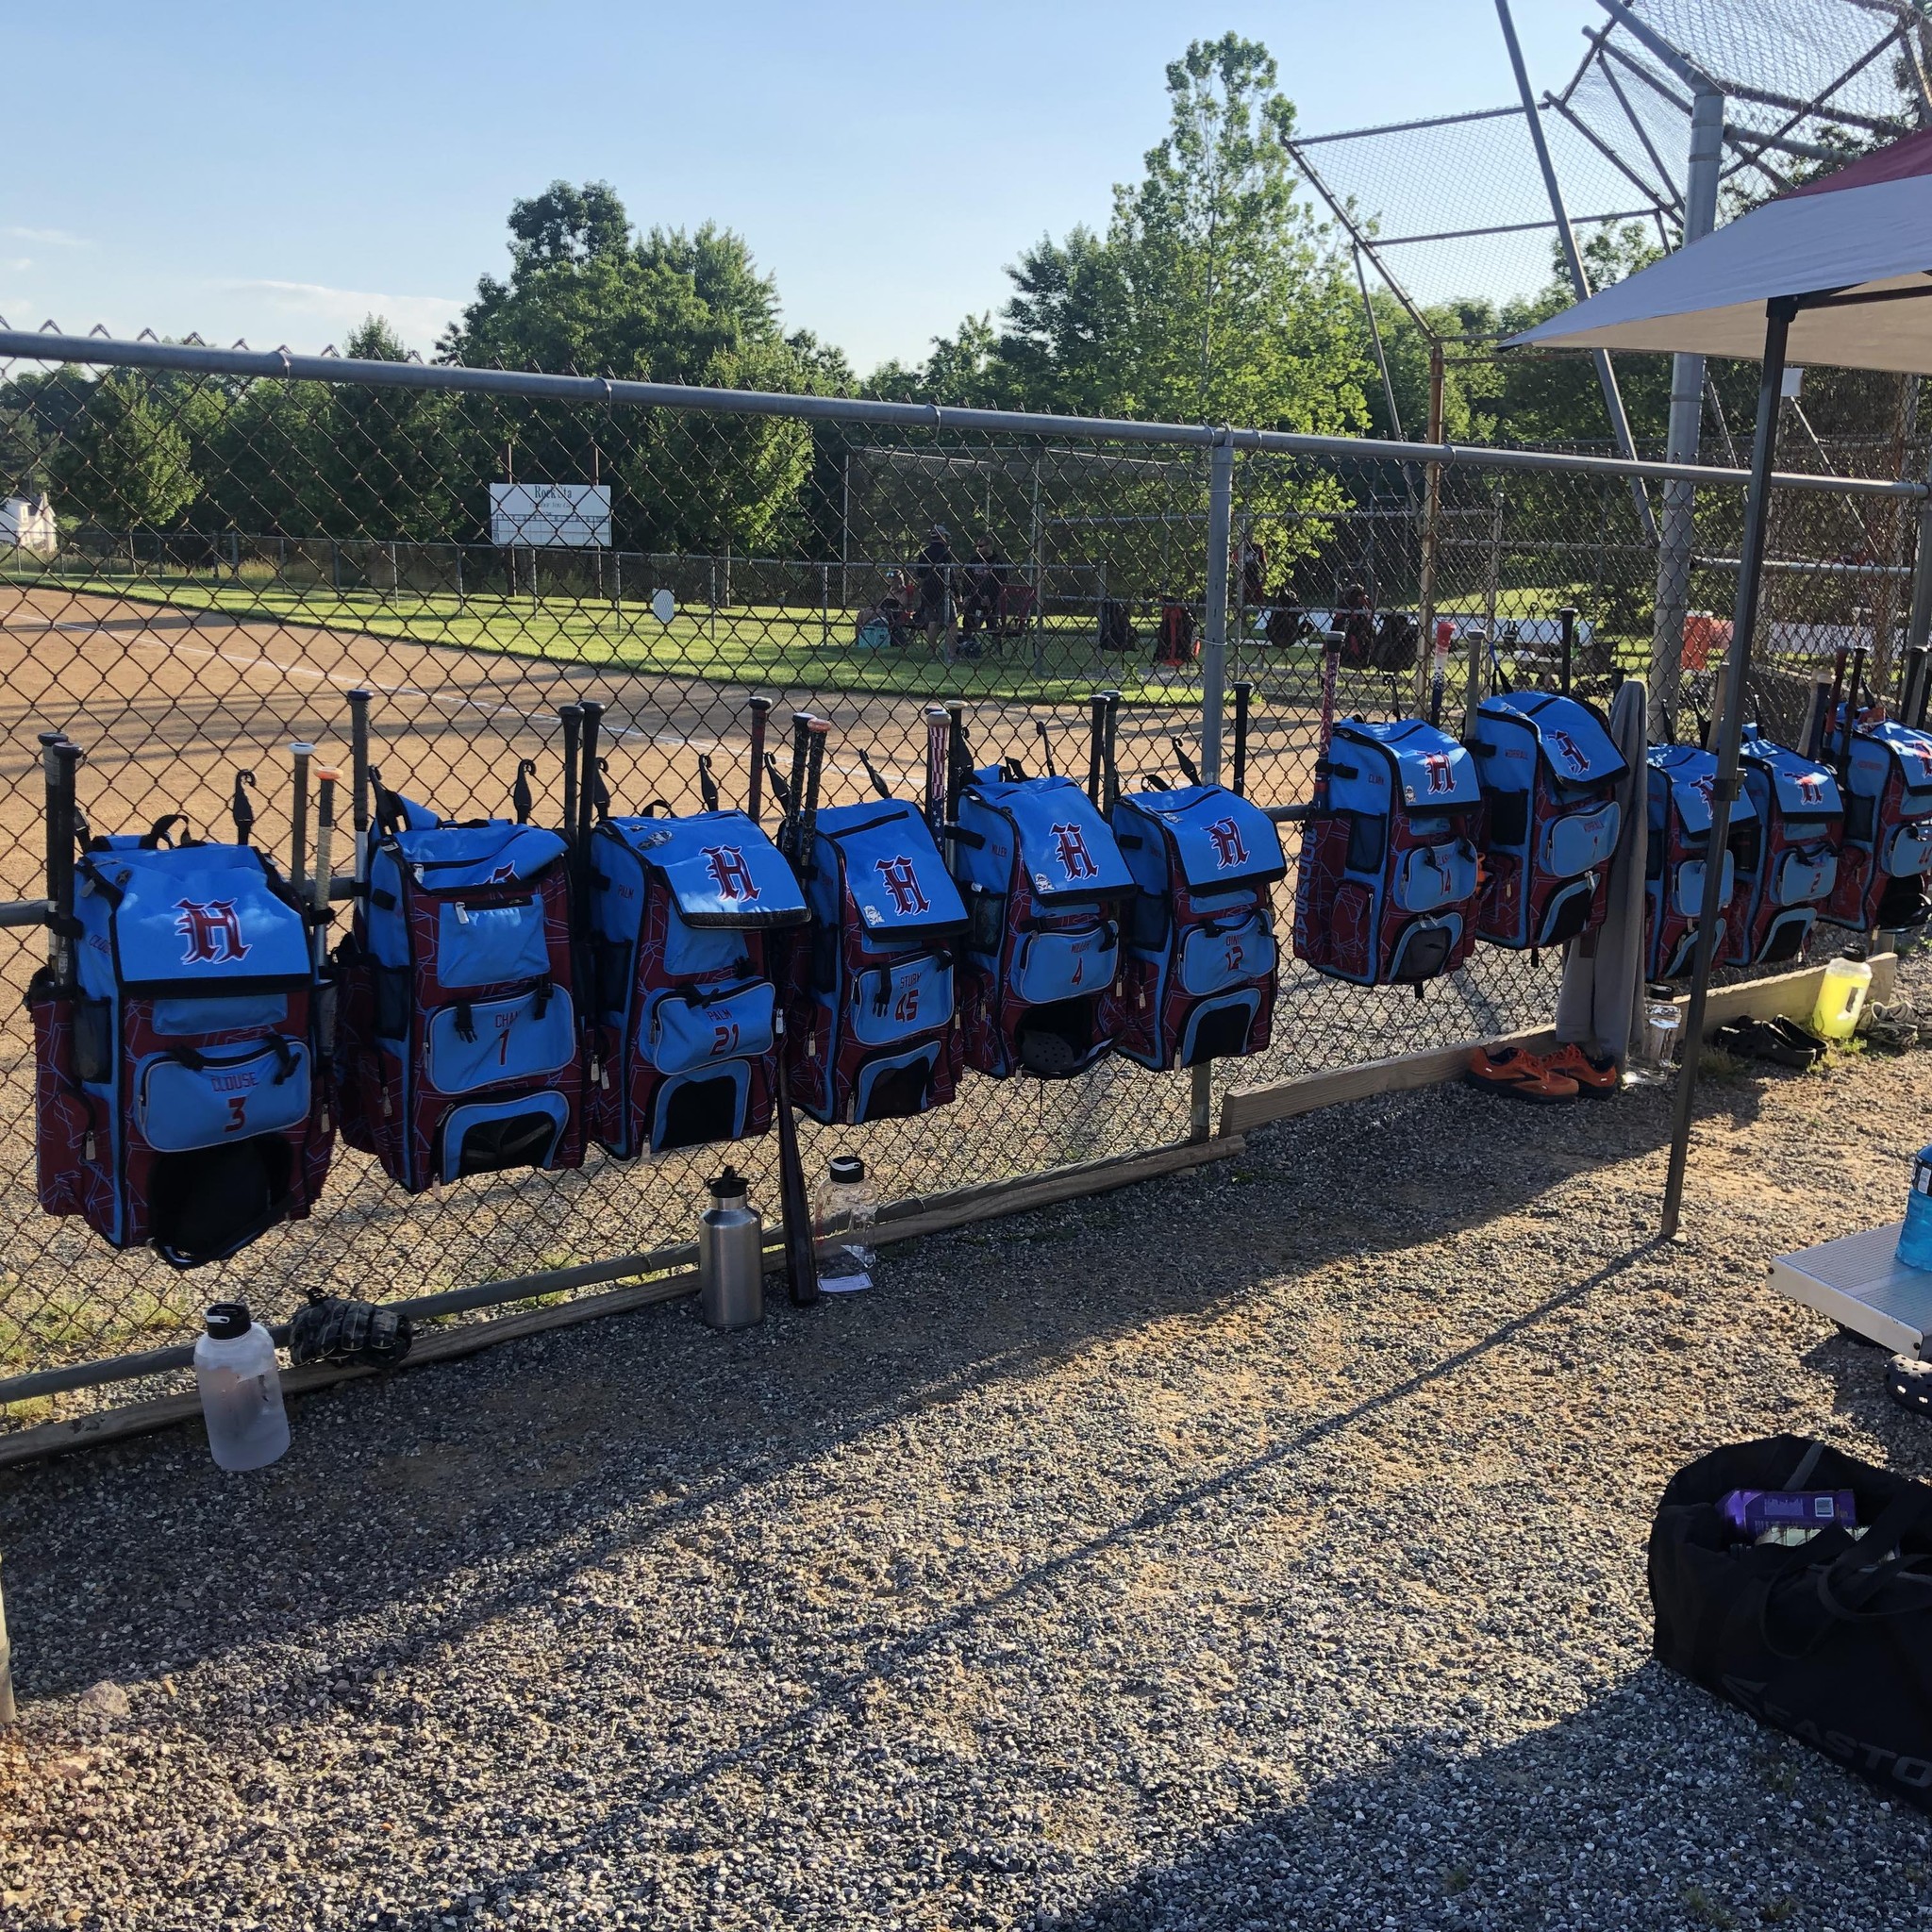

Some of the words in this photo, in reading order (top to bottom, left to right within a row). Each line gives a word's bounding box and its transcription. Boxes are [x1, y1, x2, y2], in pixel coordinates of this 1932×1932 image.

[1049, 823, 1099, 881] H
[1200, 816, 1250, 870] H
[699, 844, 761, 902] H
[874, 855, 932, 916] H
[171, 897, 253, 965] H
[1225, 945, 1244, 971] 12
[708, 1008, 732, 1022] PALM
[894, 990, 919, 1024] 45
[498, 1027, 510, 1066] 1
[709, 1024, 740, 1057] 21
[210, 1071, 258, 1092] CLOUSE
[225, 1096, 249, 1132] 3
